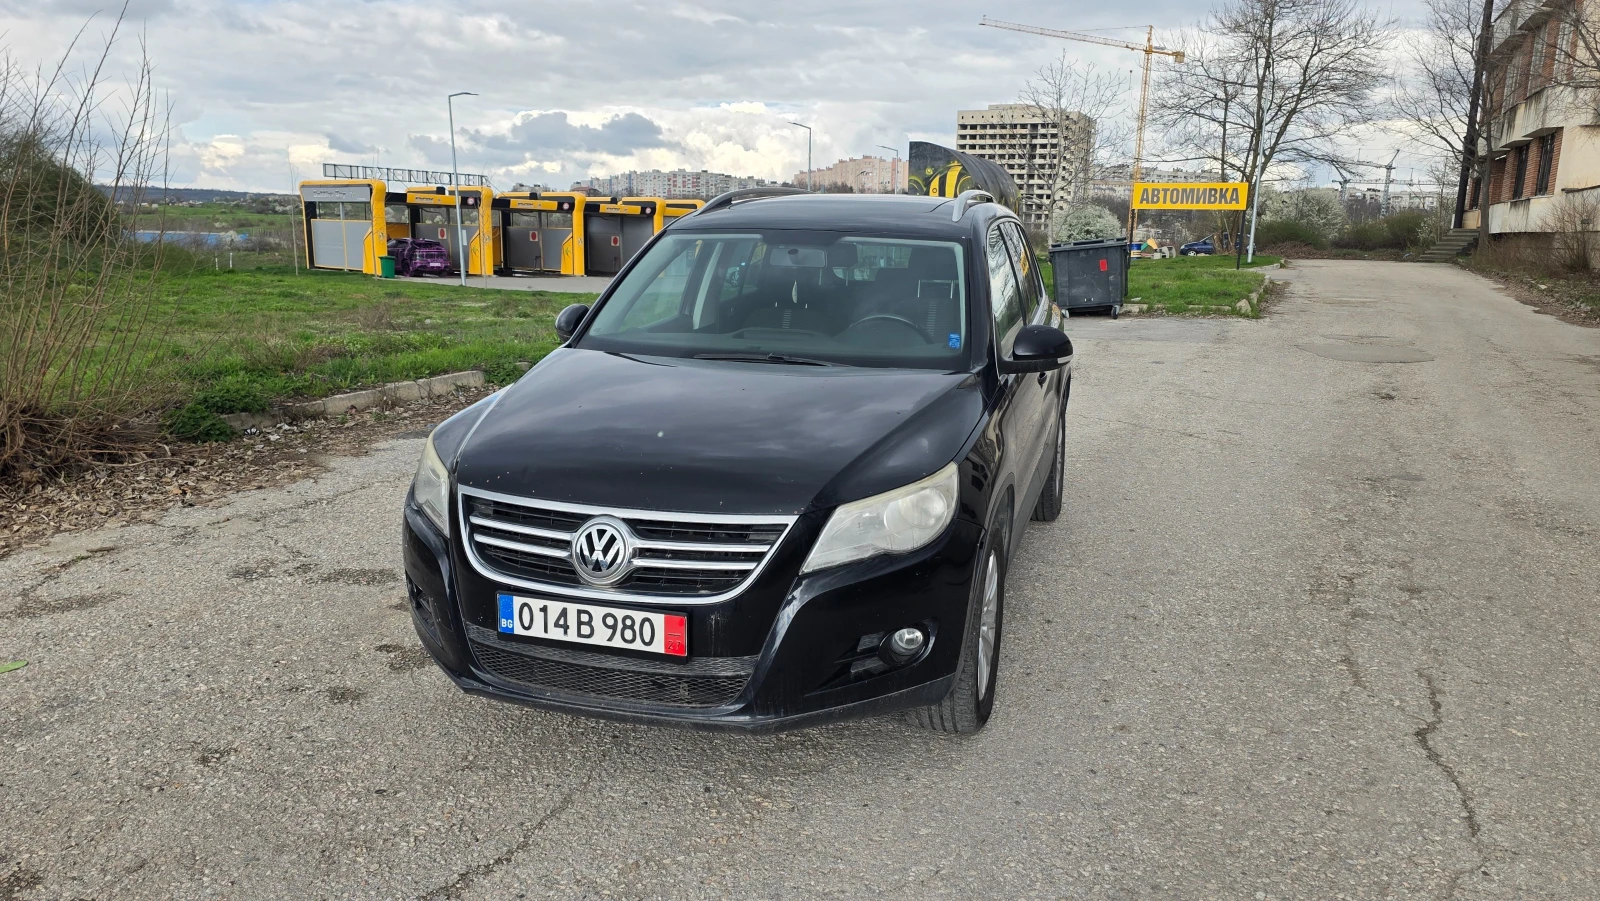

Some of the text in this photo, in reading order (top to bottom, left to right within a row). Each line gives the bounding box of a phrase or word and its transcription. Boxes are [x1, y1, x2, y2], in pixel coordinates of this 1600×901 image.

[1139, 187, 1240, 205] АВТОМИВКА
[577, 526, 623, 575] VW
[501, 618, 513, 629] BG
[518, 602, 655, 647] 014 B 980
[667, 640, 681, 650] 27
